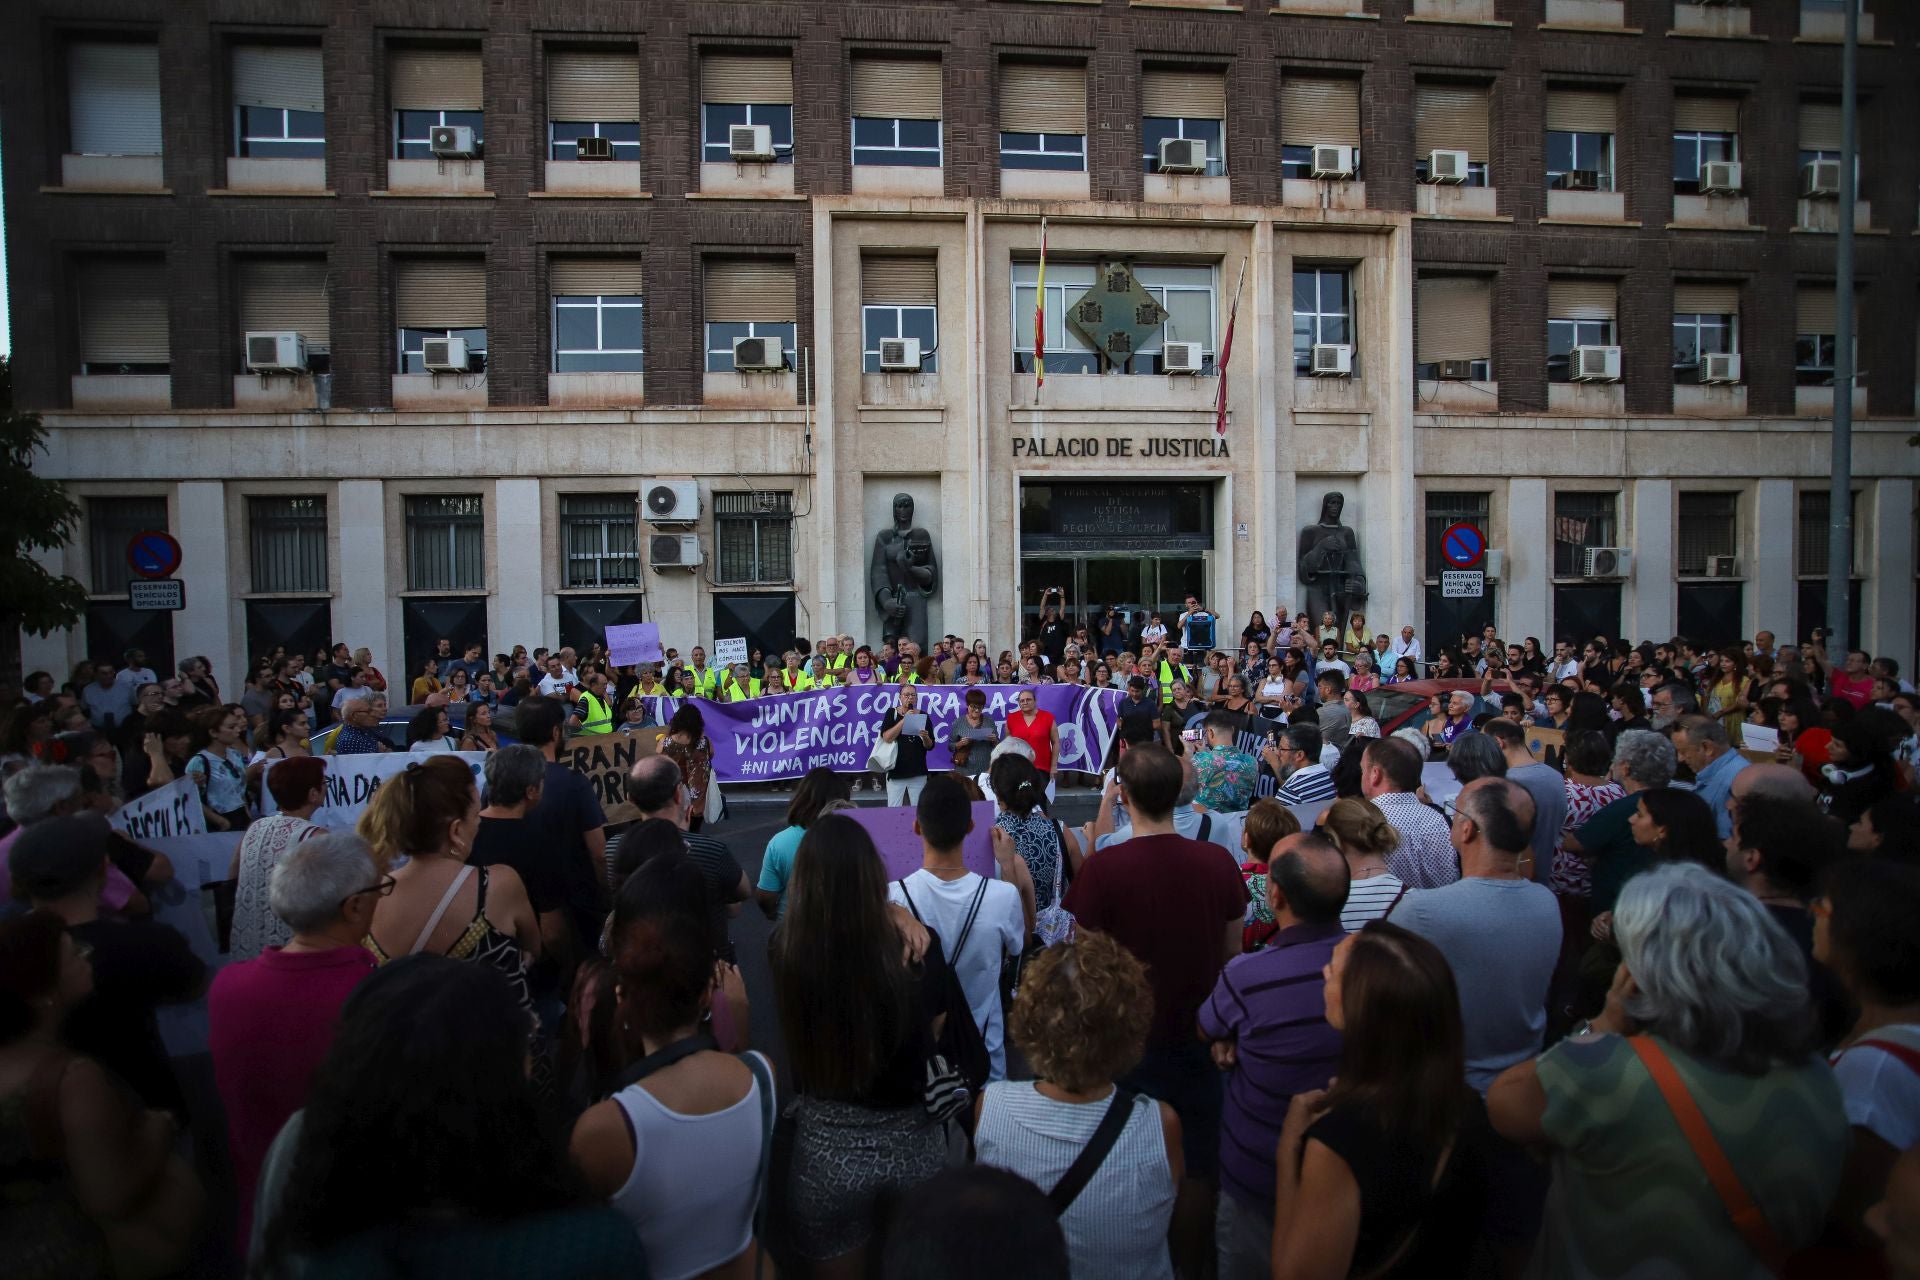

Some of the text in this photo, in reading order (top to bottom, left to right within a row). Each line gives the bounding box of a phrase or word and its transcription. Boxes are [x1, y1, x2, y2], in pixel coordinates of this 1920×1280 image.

[1012, 437, 1230, 458] PALACIO DE JUSTICIA
[1063, 487, 1168, 497] TRIBUNAL SUPERIOR
[1108, 497, 1122, 506] DE
[1092, 506, 1140, 515] JUSTICIA
[132, 583, 178, 591] RESERVADO
[136, 599, 177, 607] OFICIALES
[751, 694, 848, 728] JUNTAS
[982, 691, 1020, 719] AS
[735, 720, 884, 756] VIOLENCIAS
[741, 751, 856, 775] #NI UNA MENOS
